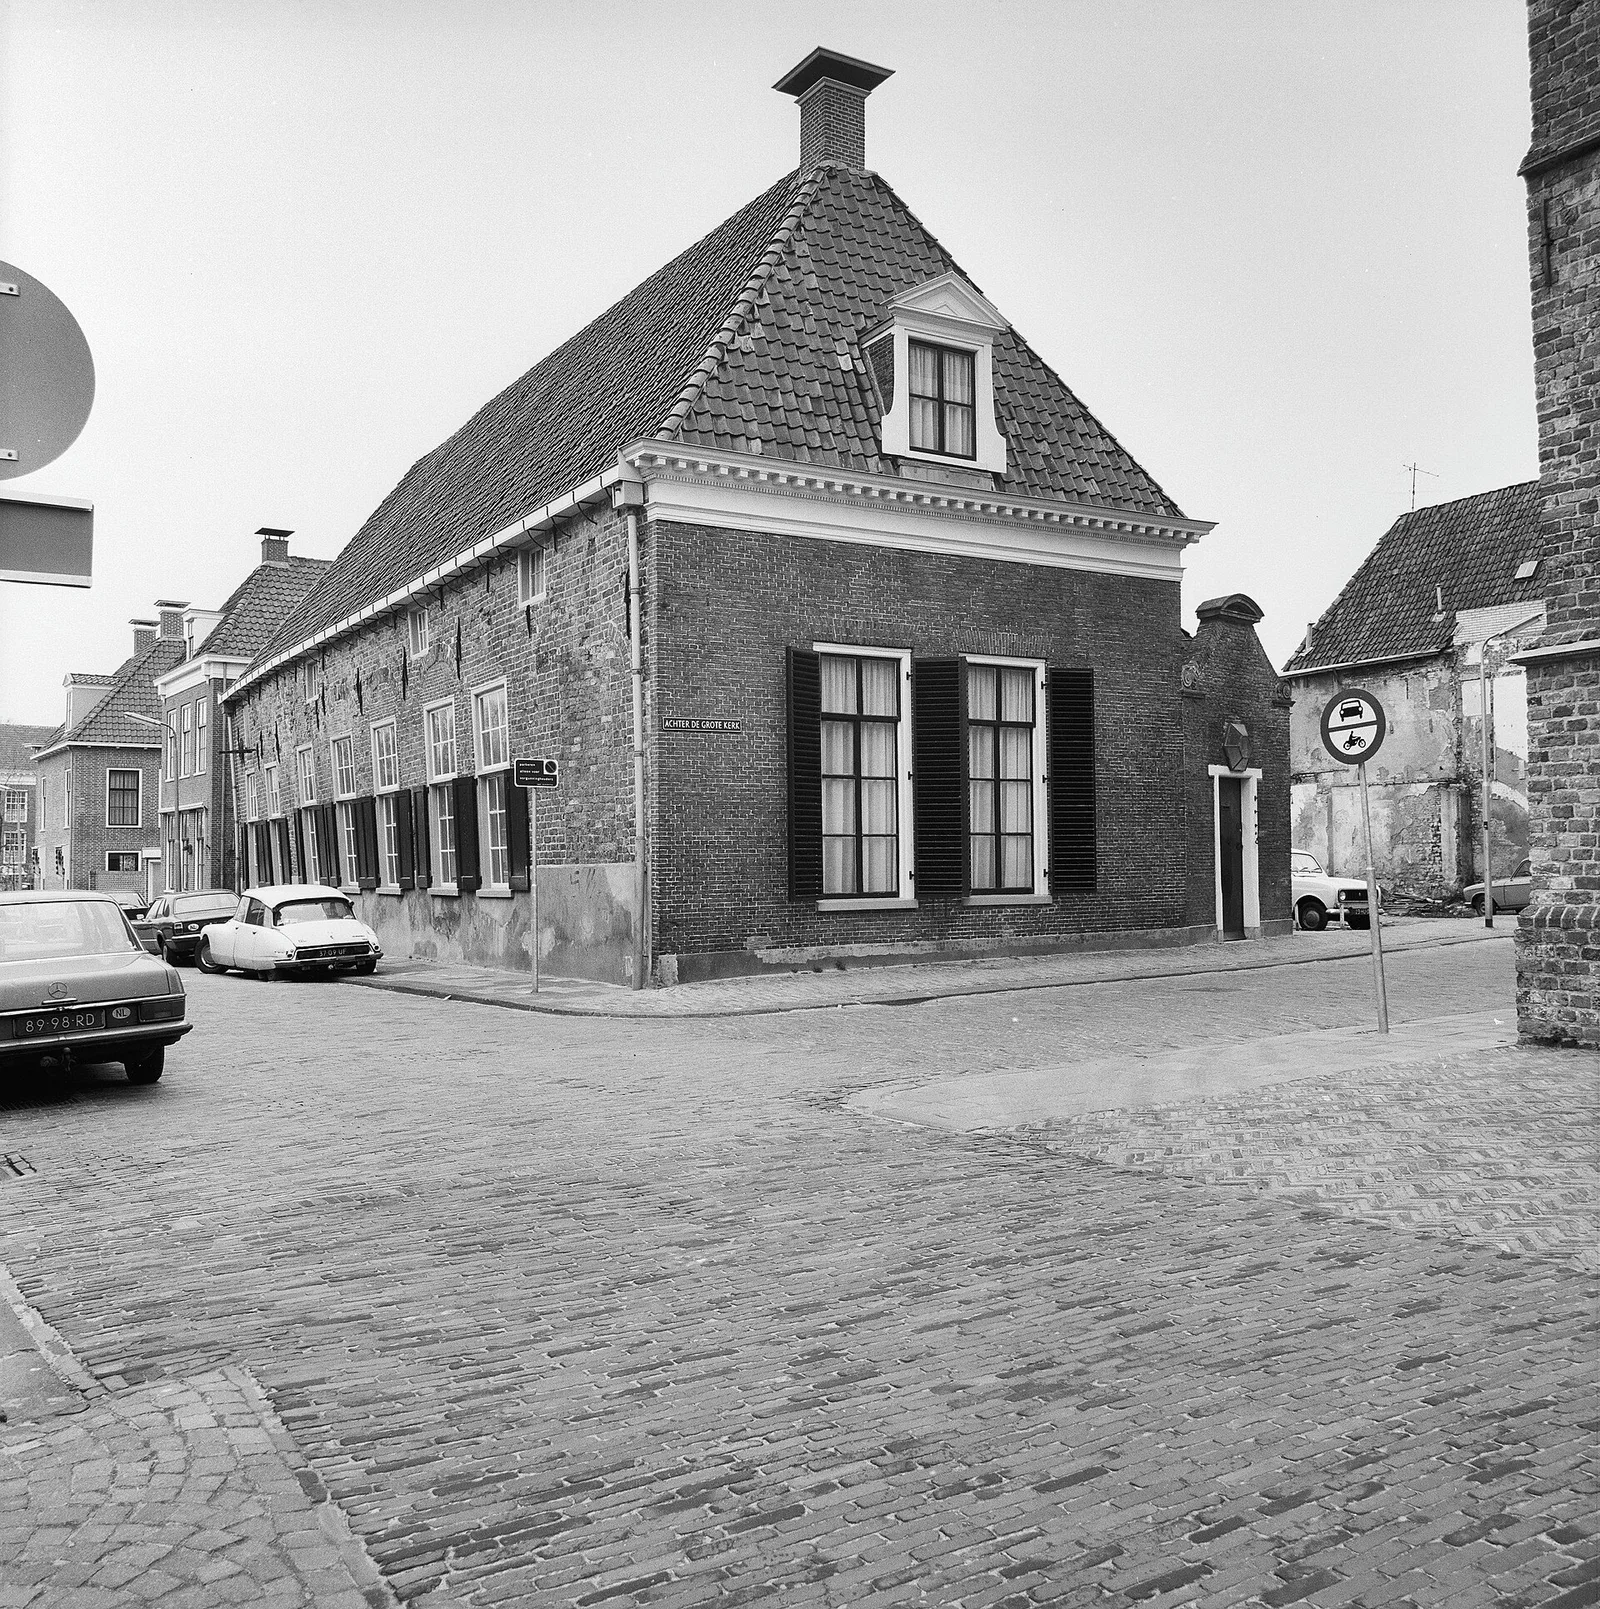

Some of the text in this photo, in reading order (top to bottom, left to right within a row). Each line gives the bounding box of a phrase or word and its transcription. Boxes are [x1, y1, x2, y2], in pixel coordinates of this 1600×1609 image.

[665, 720, 740, 729] ACHTER DE GROTE KERK
[115, 1008, 127, 1018] NL
[26, 1013, 95, 1032] 89-98-RD
